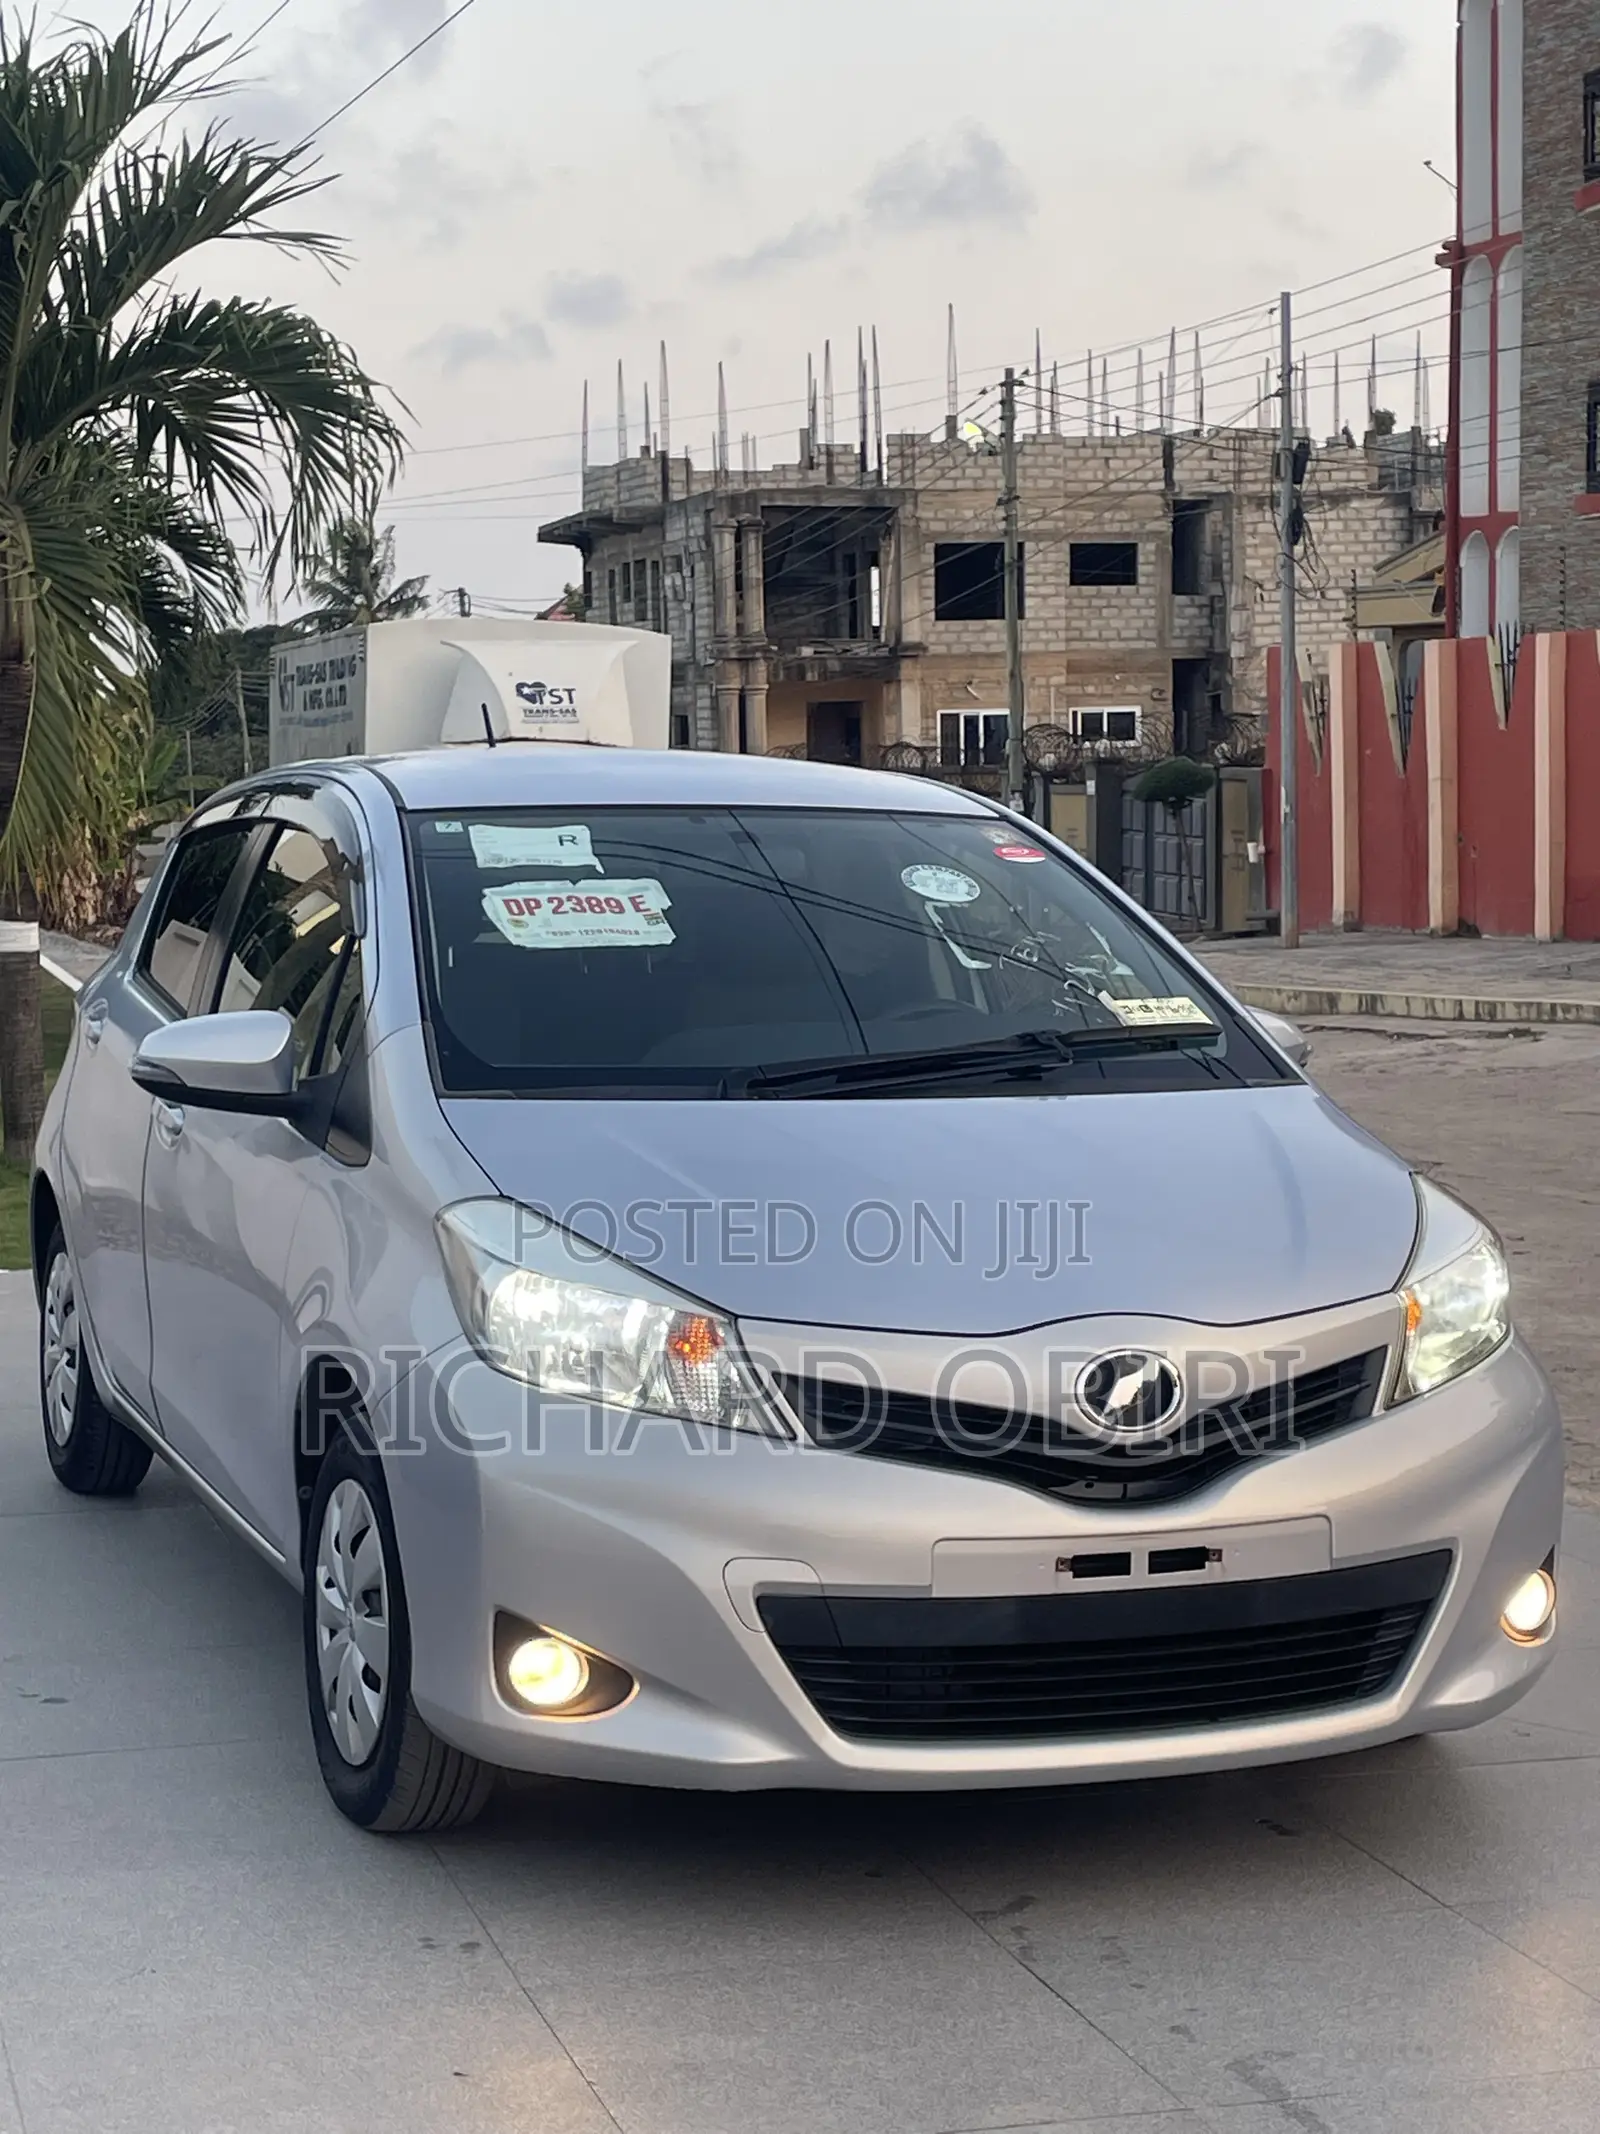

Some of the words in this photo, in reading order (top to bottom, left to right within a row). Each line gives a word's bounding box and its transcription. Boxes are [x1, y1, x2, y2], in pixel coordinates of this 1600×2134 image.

[557, 834, 579, 847] R
[547, 895, 626, 915] 2389
[628, 894, 652, 912] E
